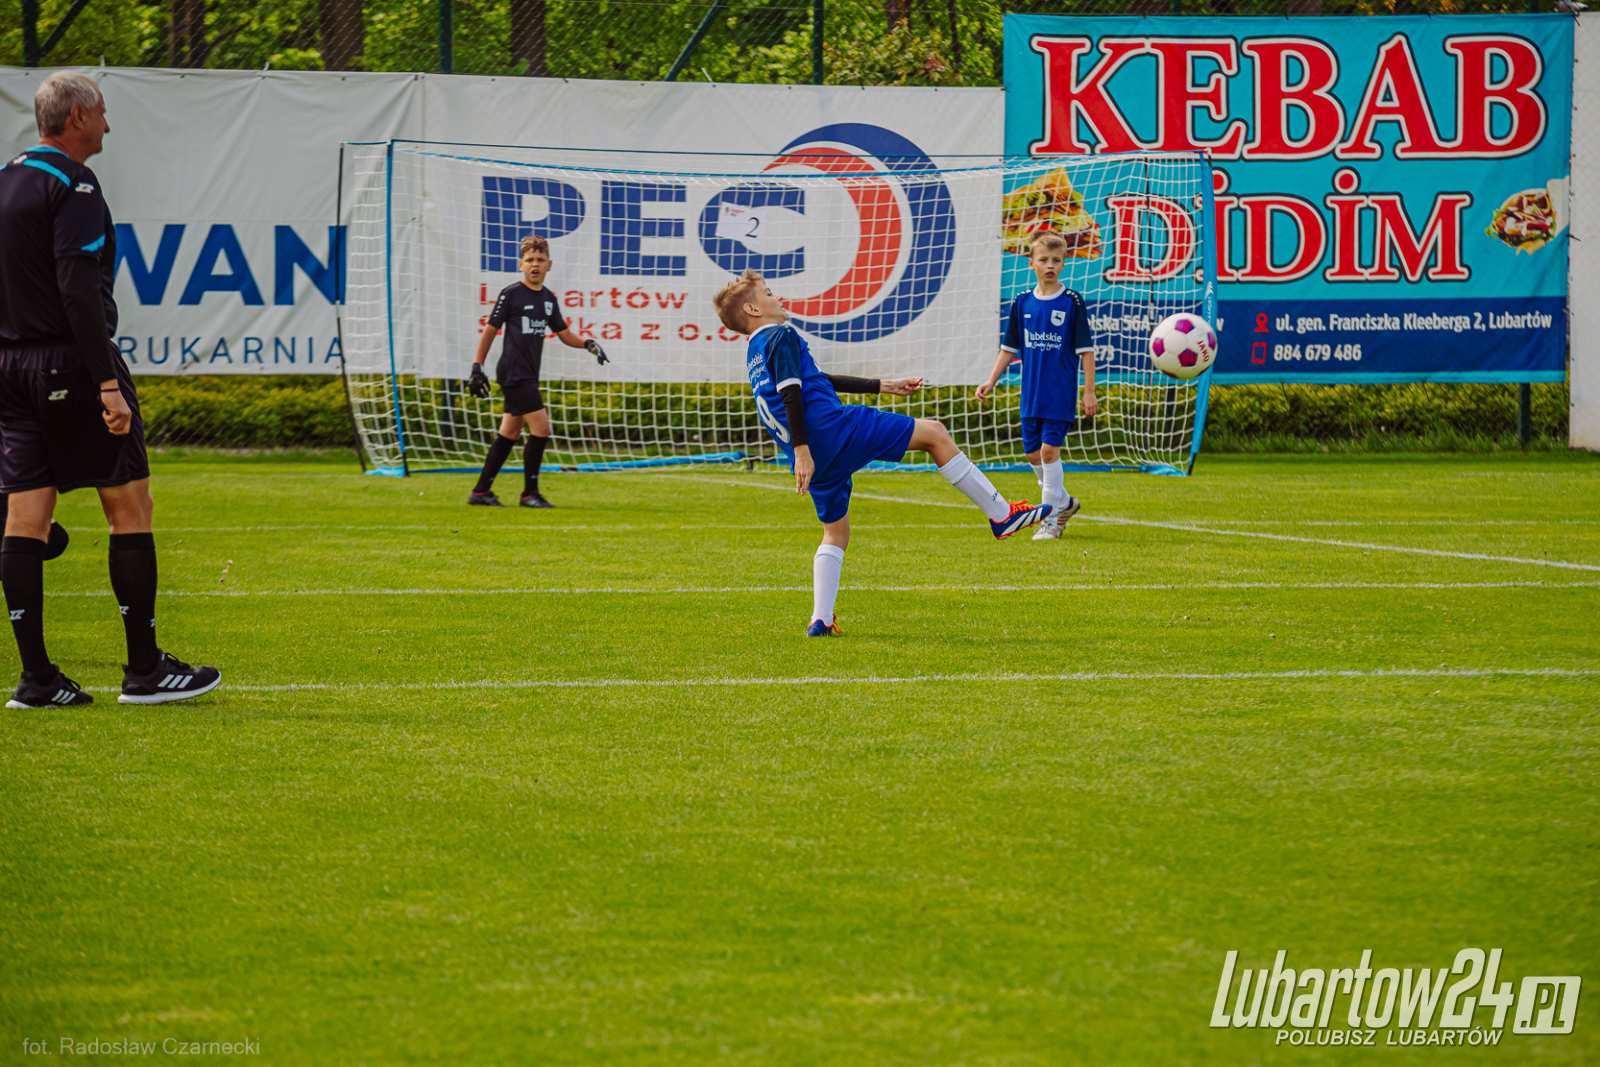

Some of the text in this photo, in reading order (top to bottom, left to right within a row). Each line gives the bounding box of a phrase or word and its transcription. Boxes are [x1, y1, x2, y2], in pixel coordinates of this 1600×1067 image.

[1030, 33, 1547, 161] KEBAB
[481, 175, 806, 280] PEC
[745, 217, 760, 238] 2
[479, 282, 686, 309] Lartów
[640, 323, 660, 341] z
[678, 323, 749, 342] o.o
[1275, 310, 1552, 333] ul. gen. Franciszka Kleeberga 2, Lubartów
[118, 336, 345, 364] RUKARNIA
[1274, 344, 1362, 361] 884 679 486
